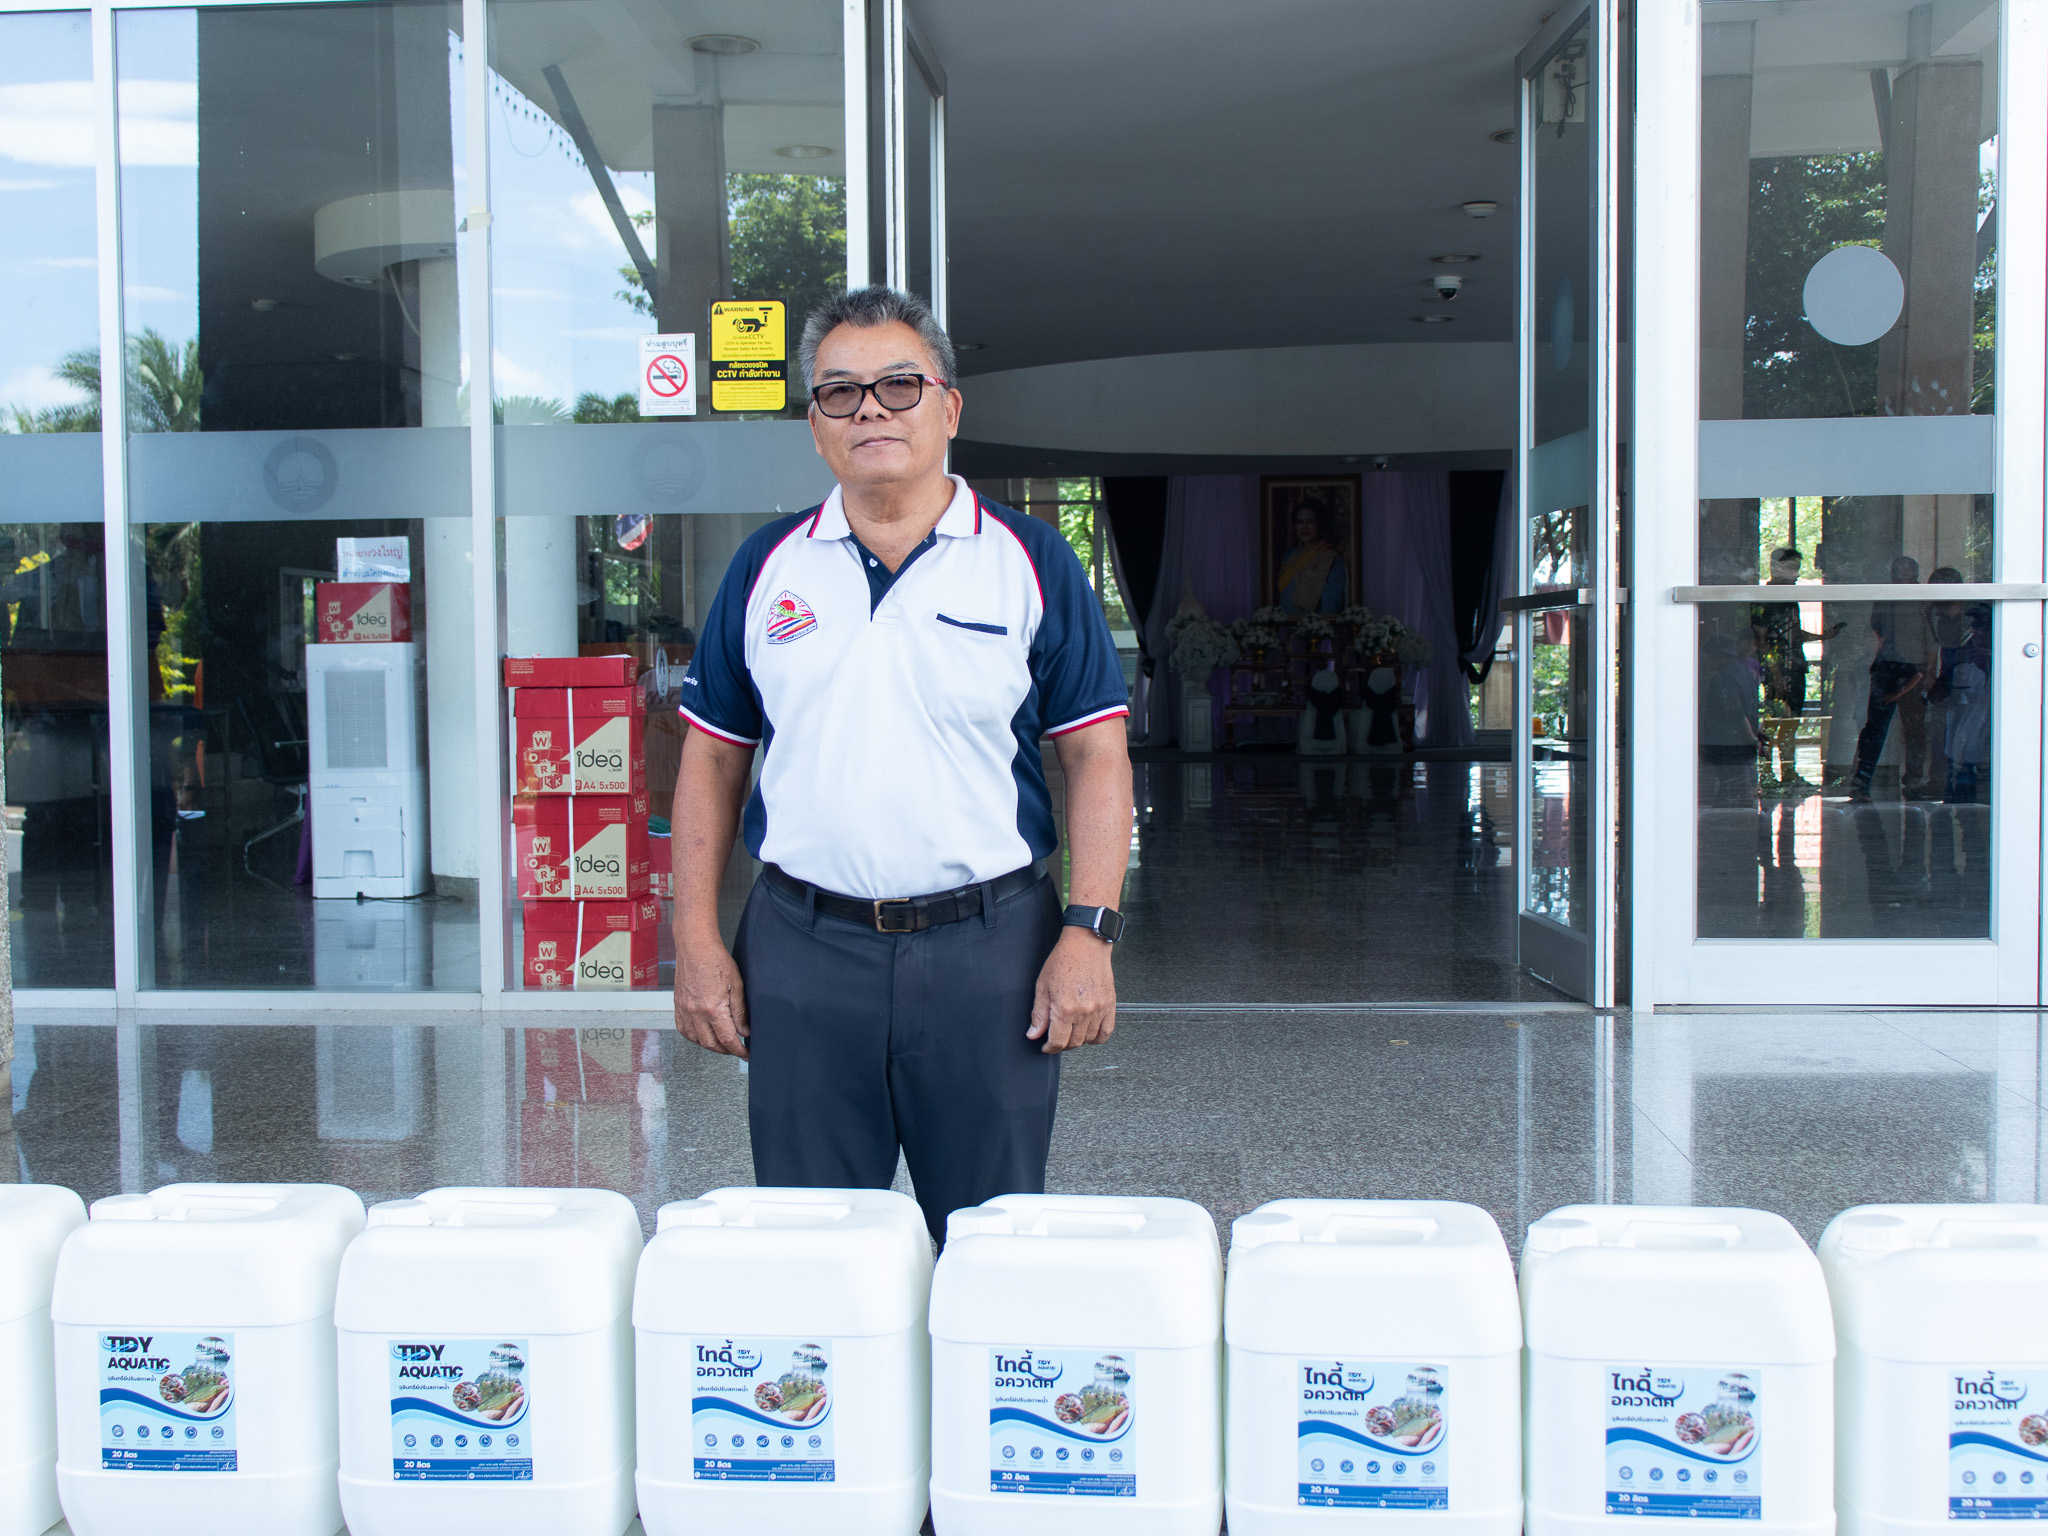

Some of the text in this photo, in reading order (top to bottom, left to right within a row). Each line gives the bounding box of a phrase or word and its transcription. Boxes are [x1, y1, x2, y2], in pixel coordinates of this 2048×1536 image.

[716, 369, 781, 378] CCTV กำลังทำงาน
[356, 612, 386, 625] idea
[576, 749, 622, 767] idea
[583, 781, 596, 789] A4
[599, 781, 625, 789] 5x500
[575, 854, 619, 873] idea
[582, 886, 594, 895] A4
[597, 886, 623, 895] 5x500
[580, 960, 624, 979] idea
[107, 1336, 153, 1353] TIDY
[696, 1339, 733, 1362] ไทดี้
[398, 1344, 445, 1361] TIDY
[107, 1357, 170, 1370] AQUATIC
[995, 1349, 1033, 1373] ไทดี้
[399, 1366, 463, 1379] AQUATIC
[1304, 1361, 1343, 1385] ไทดี้
[1611, 1367, 1652, 1391] ไทดี้
[1955, 1370, 1995, 1394] ไทดี้
[112, 1450, 138, 1459] 20 ลิตร
[404, 1460, 431, 1469] 20 ลิตร
[704, 1460, 732, 1469] 20 ลิตร
[1002, 1472, 1030, 1481] 20 ลิตร
[1310, 1485, 1339, 1494] 20 ลิตร
[1618, 1494, 1649, 1503] 20 ลิตร
[1961, 1498, 1974, 1507] 20
